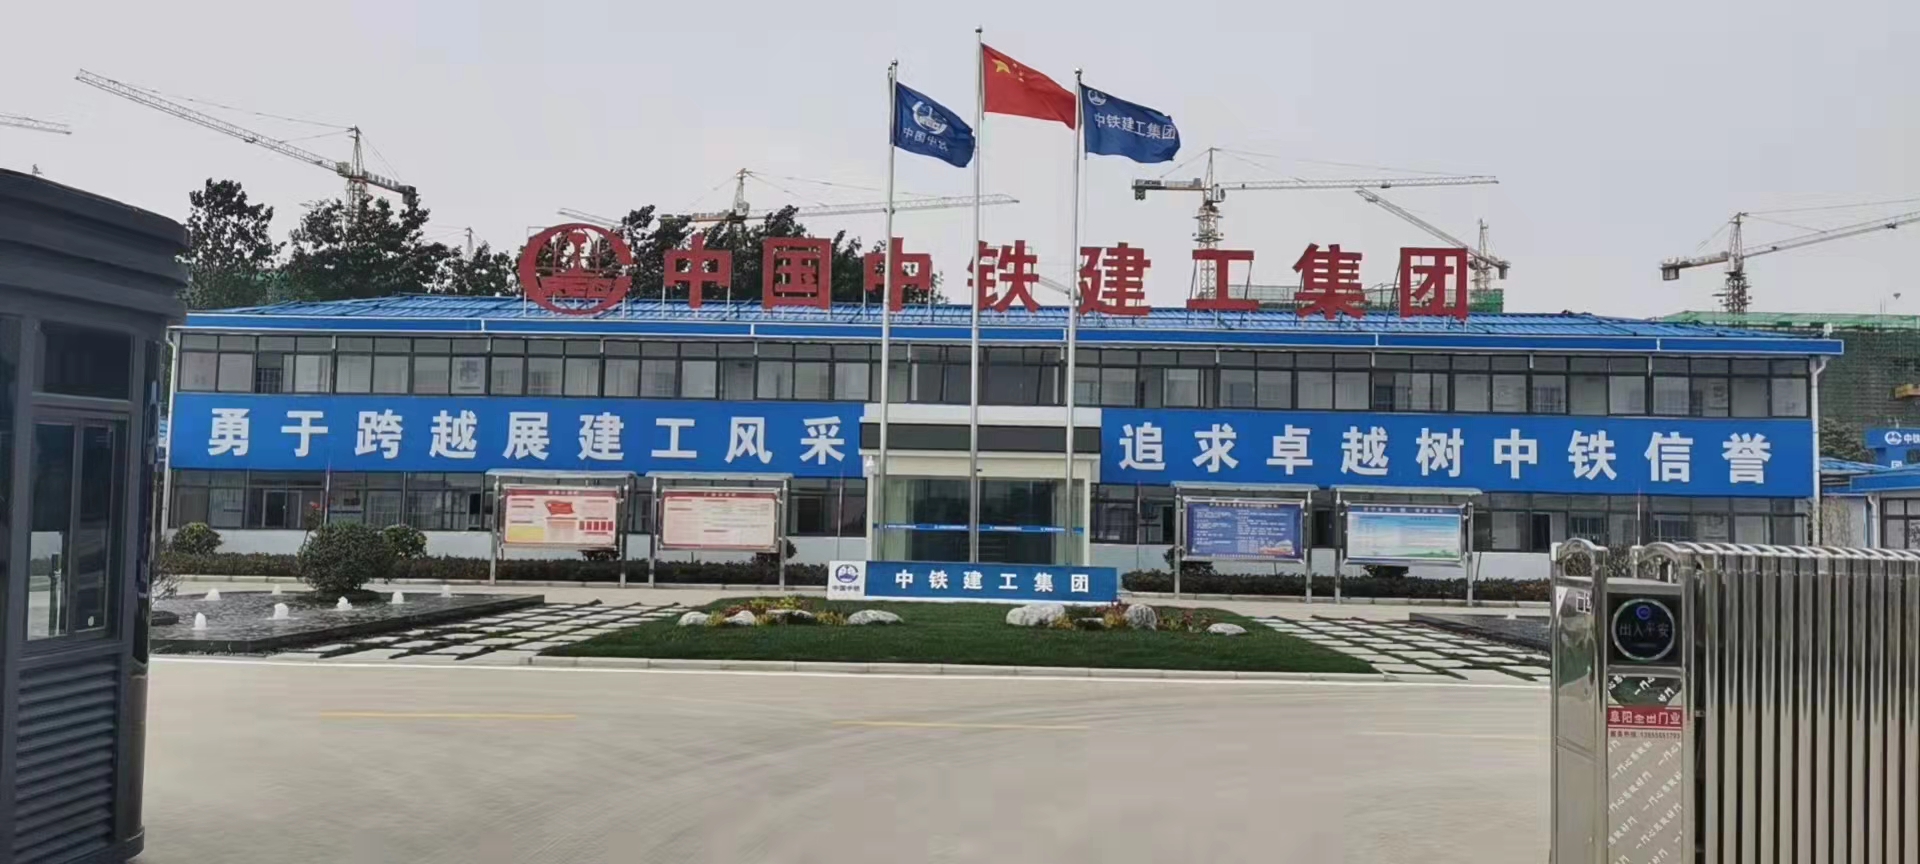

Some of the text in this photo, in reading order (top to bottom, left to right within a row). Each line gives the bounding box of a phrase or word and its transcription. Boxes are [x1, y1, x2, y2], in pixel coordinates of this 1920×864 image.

[1094, 113, 1176, 139] 中铁建工集团
[663, 236, 1468, 318] 中国中铁建工集团
[207, 408, 845, 465] 勇于跨越展建工风采
[1119, 422, 1772, 485] 追求卓越树中铁信誉
[895, 569, 1089, 593] 中铁建工集团
[1619, 622, 1669, 638] 出入平安
